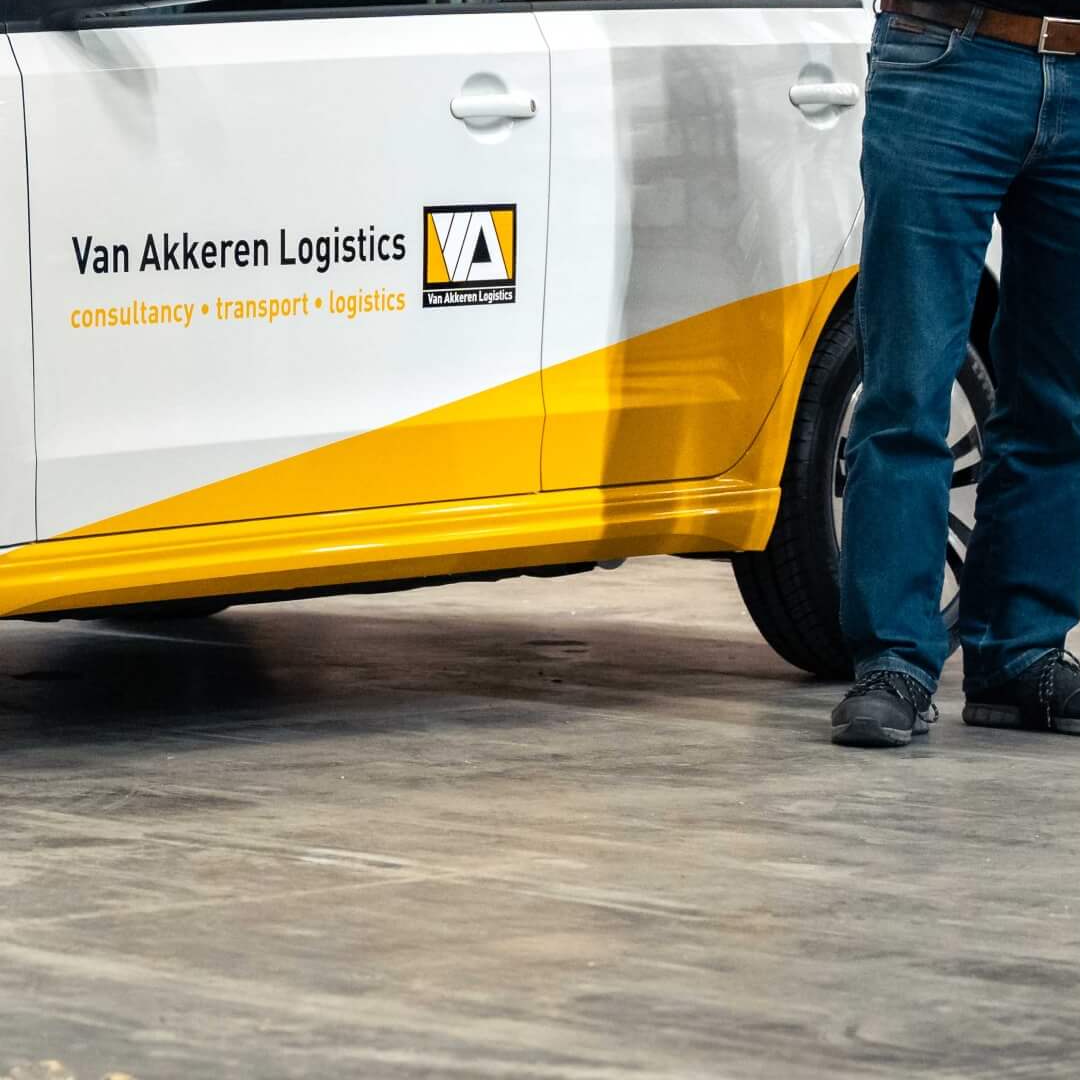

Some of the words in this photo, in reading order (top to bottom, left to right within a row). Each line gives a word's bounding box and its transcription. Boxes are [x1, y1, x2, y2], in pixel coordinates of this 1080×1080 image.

[72, 236, 129, 275] Van
[140, 232, 269, 271] Akkeren
[280, 226, 406, 273] Logistics
[430, 211, 510, 282] VA
[70, 300, 194, 328] consultancy
[216, 292, 308, 323] transport
[329, 287, 406, 319] logistics
[428, 293, 442, 304] Van
[444, 291, 477, 303] Akkeren
[479, 289, 512, 303] Logistics
